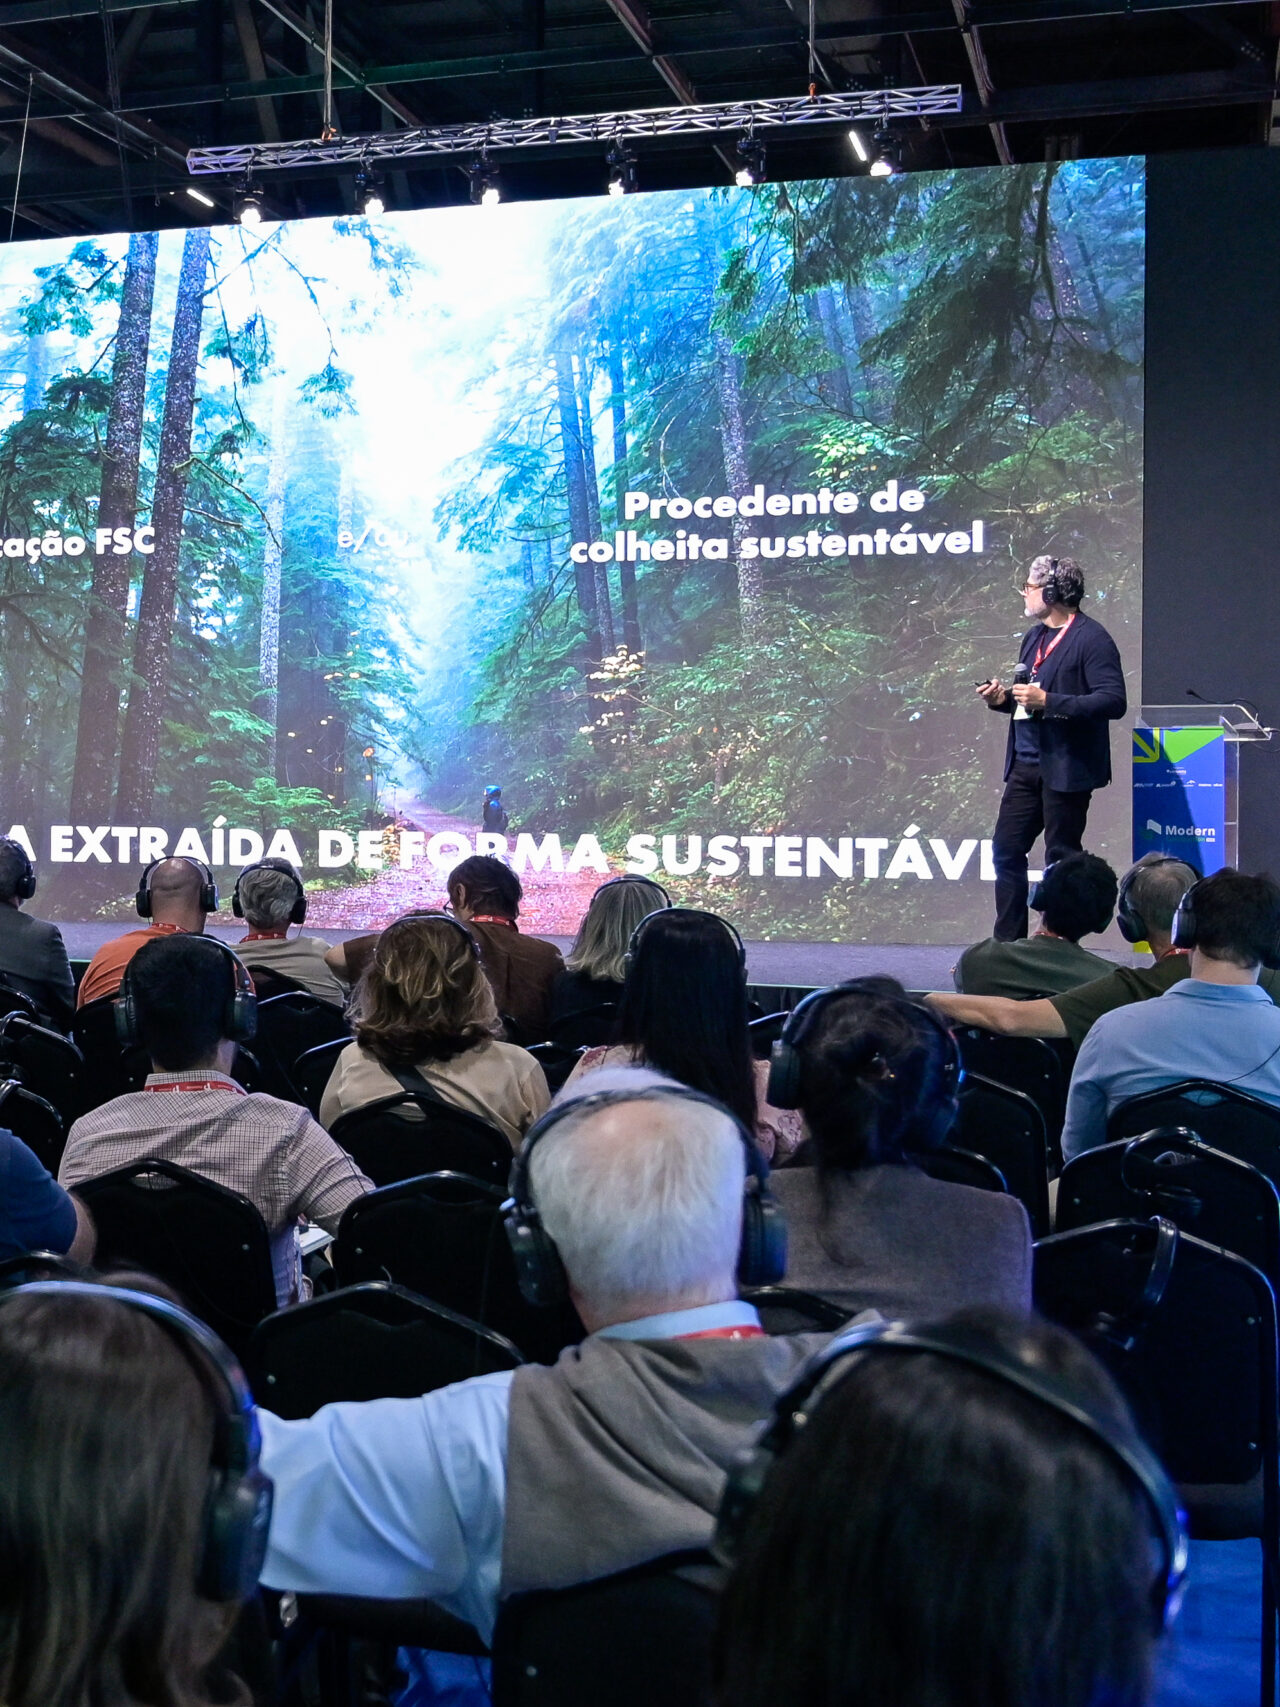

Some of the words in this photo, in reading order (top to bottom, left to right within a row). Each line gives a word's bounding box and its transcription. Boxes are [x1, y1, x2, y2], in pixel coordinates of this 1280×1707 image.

[624, 484, 859, 520] Procedente
[869, 480, 926, 513] de
[95, 527, 156, 554] FSC
[569, 530, 728, 563] colheita
[740, 520, 984, 558] sustentável
[50, 815, 303, 867] EXTRAÍDA
[318, 829, 385, 869] DE
[399, 830, 612, 873] FORMA
[1165, 825, 1216, 836] Modern
